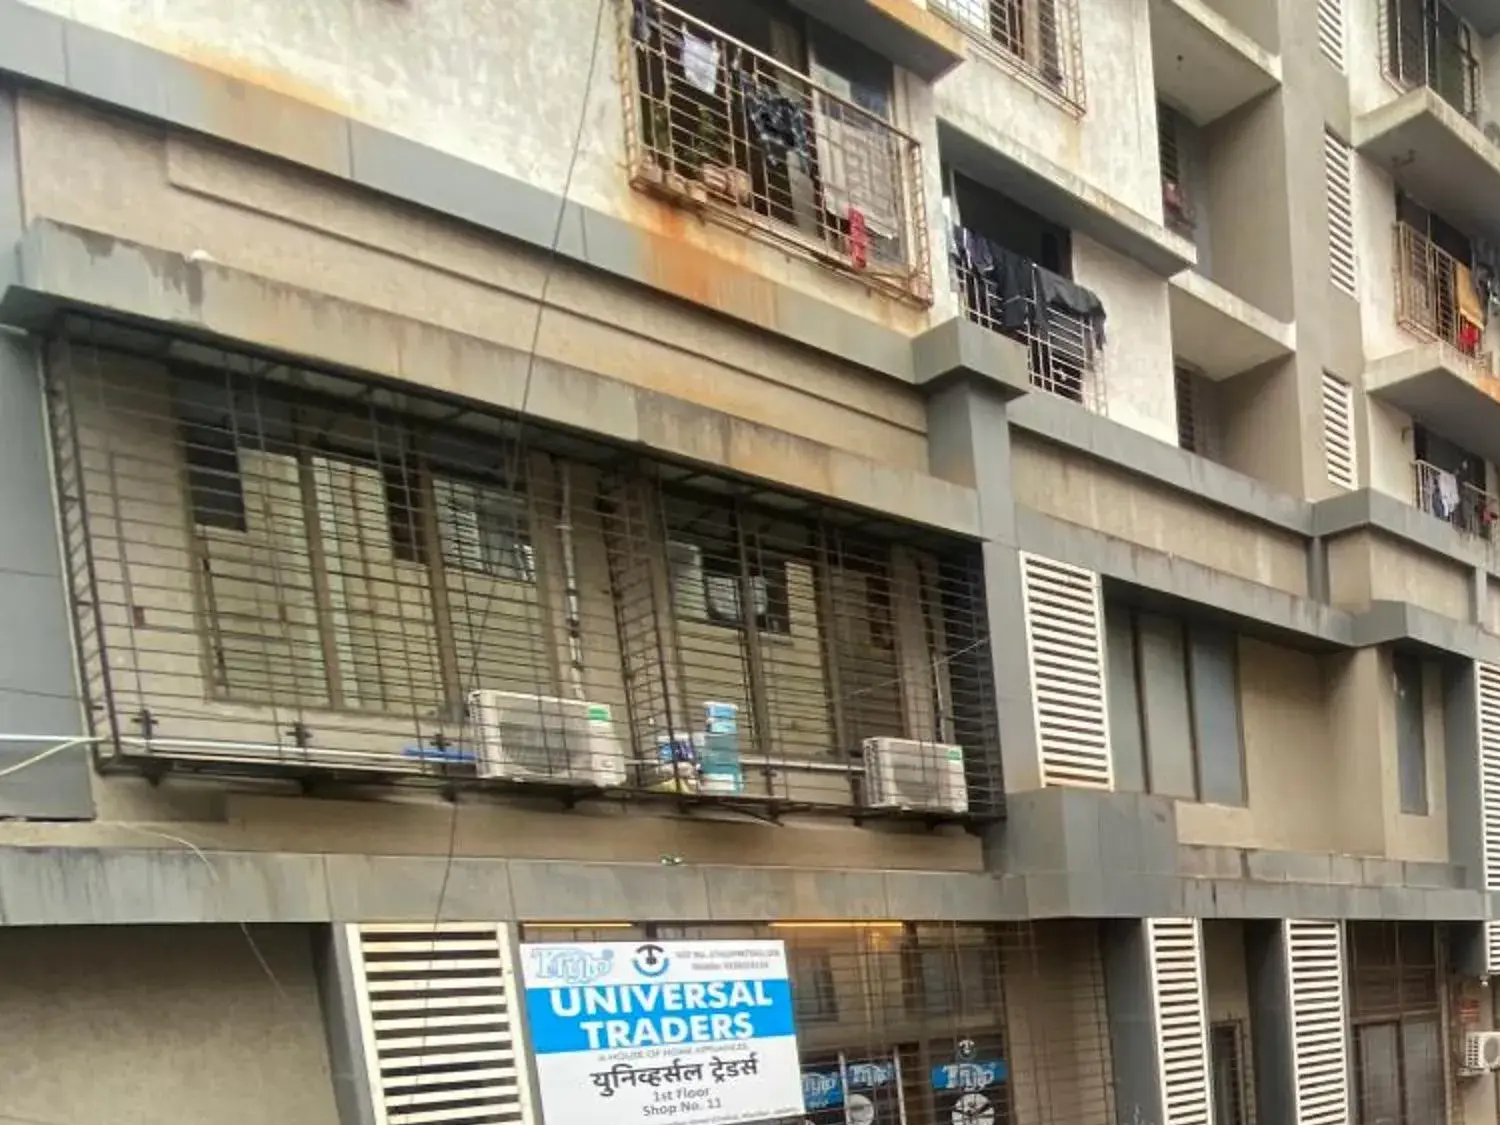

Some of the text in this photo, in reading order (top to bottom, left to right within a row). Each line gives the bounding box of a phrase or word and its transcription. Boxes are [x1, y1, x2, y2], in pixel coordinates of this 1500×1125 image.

[551, 980, 773, 1017] UNIVERSAL
[580, 1012, 753, 1050] TRADERS
[590, 1052, 759, 1097] युनिव्हर्सल ट्रेडर्स
[643, 1103, 677, 1117] Shop
[654, 1087, 711, 1102] 1st Floor
